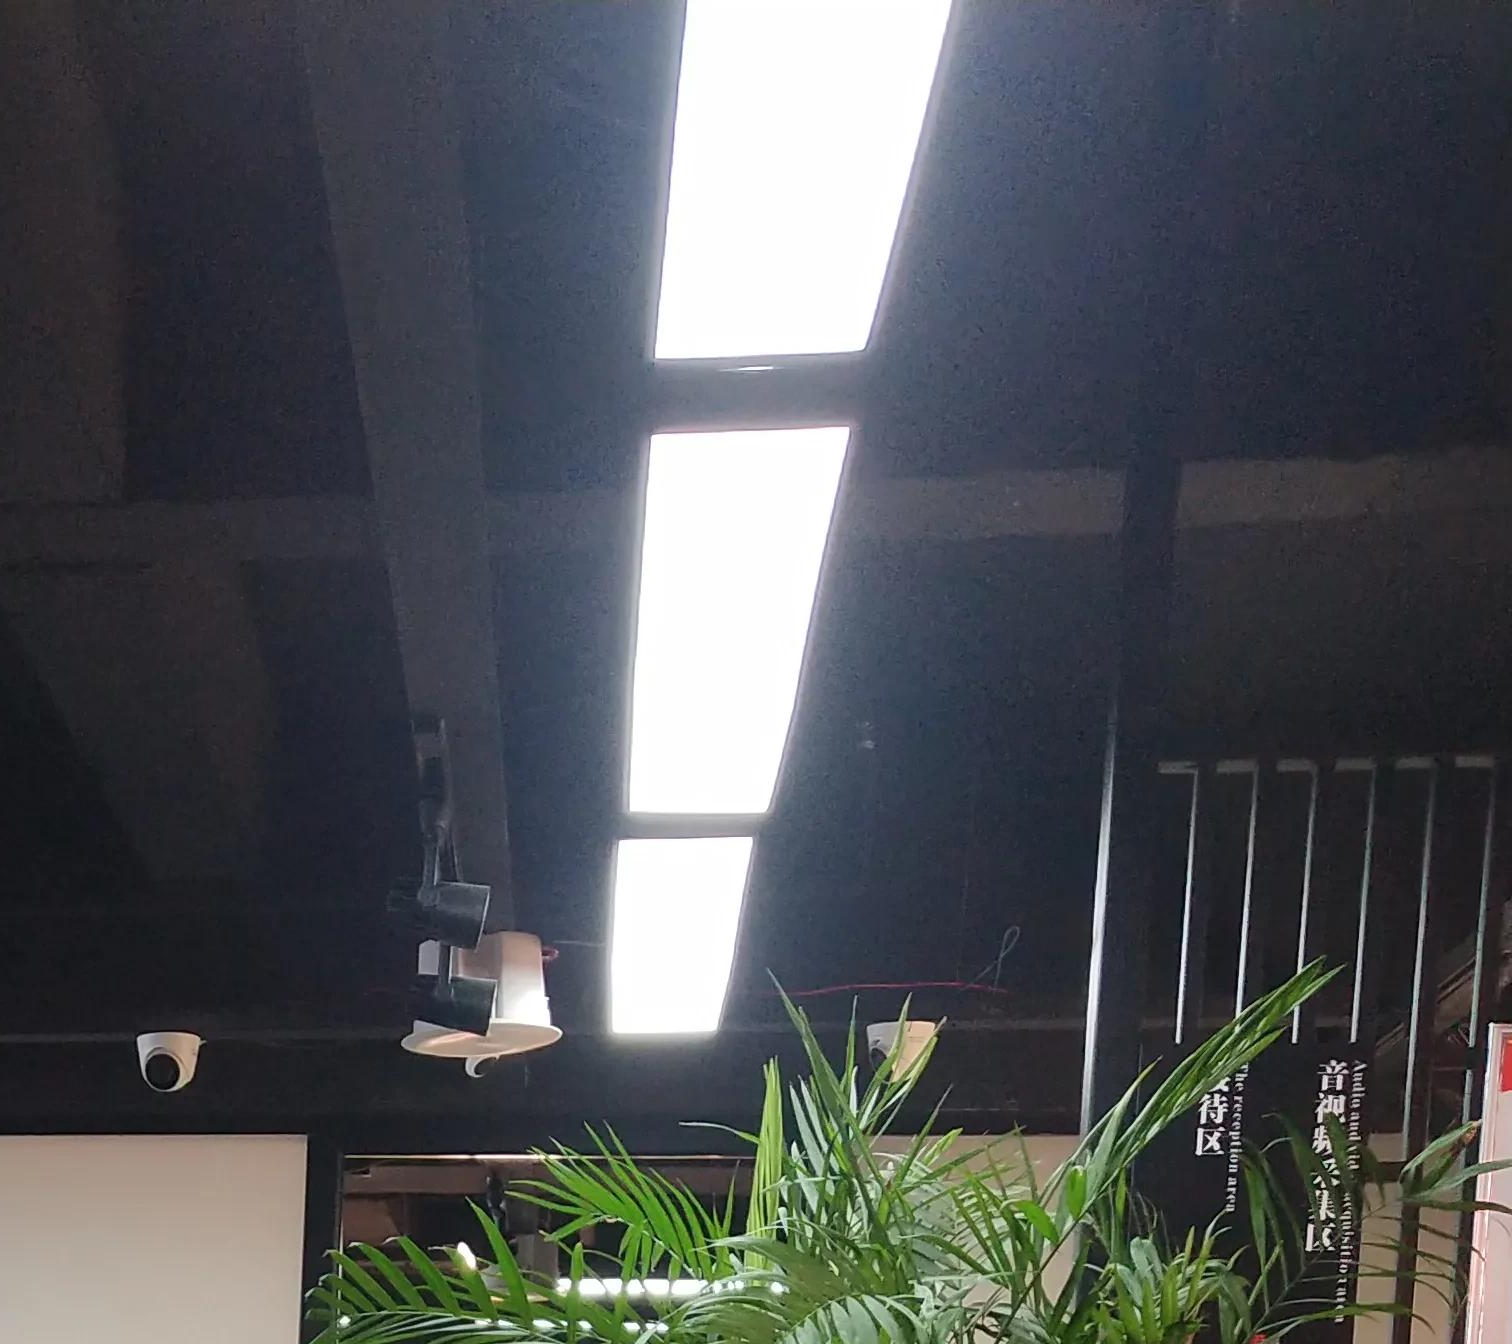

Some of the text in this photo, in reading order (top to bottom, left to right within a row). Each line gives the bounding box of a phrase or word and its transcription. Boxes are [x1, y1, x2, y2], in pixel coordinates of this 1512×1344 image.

[1194, 1076, 1232, 1157] 待区
[1227, 1094, 1245, 1173] reception
[1347, 1110, 1363, 1142] and
[1224, 1176, 1238, 1213] area
